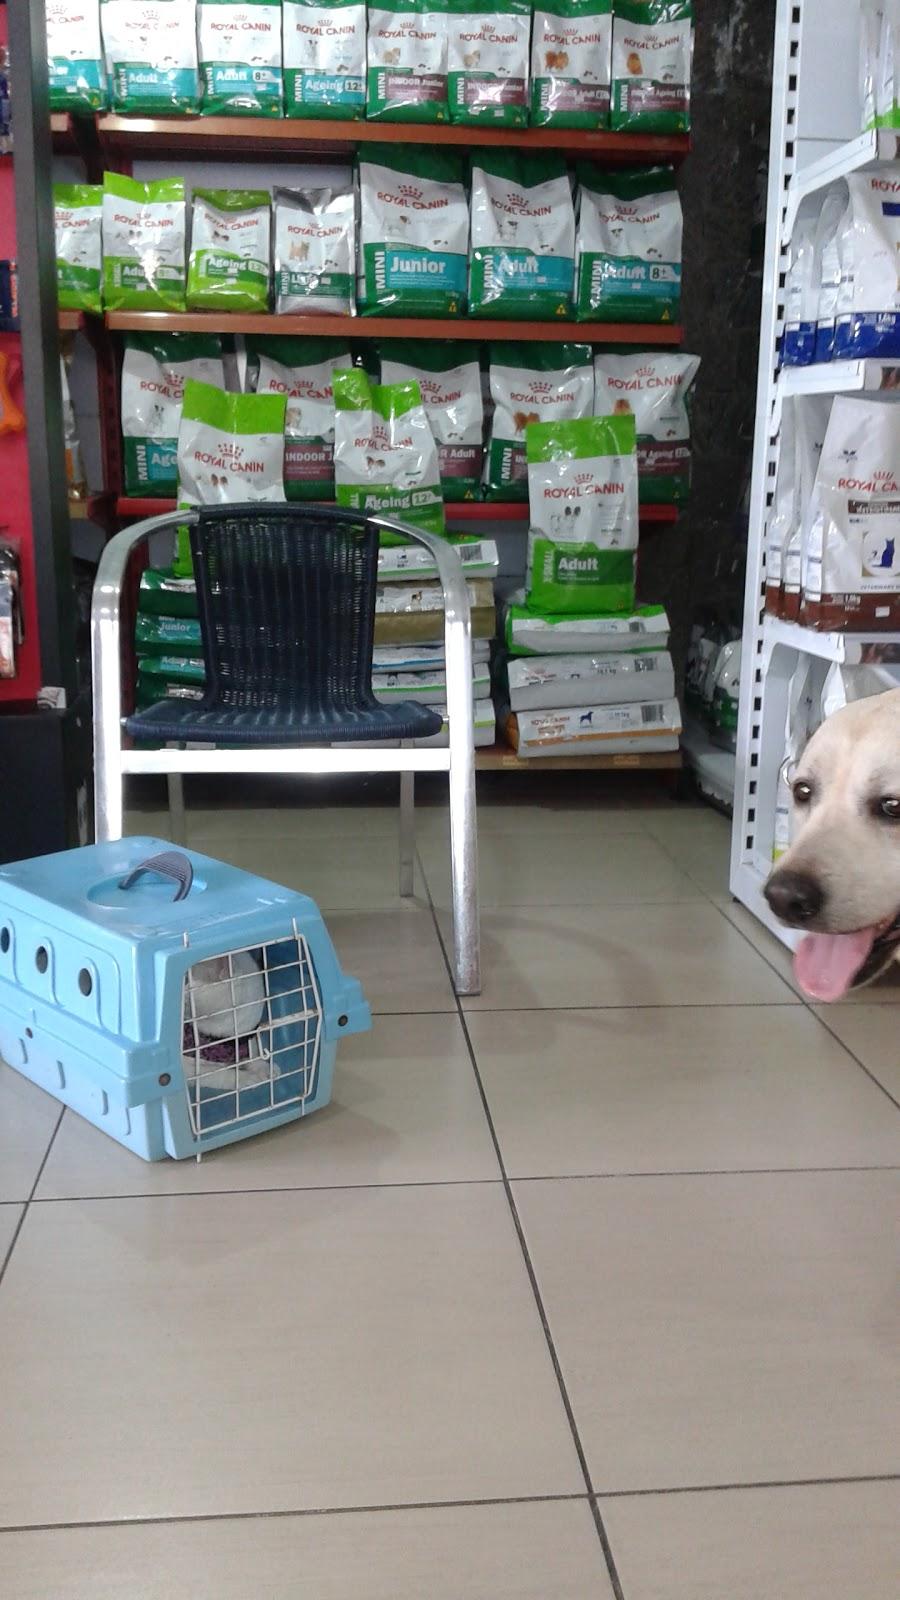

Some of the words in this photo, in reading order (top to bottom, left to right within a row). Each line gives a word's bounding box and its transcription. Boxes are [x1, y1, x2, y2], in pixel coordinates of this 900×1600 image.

[210, 22, 239, 31] ROYAL
[242, 23, 272, 32] CANIN
[296, 24, 323, 36] ROYAL
[326, 24, 355, 35] CANIN
[378, 29, 409, 39] ROYAL
[411, 31, 437, 41] CANIN
[459, 33, 486, 42] ROYAL
[488, 34, 518, 43] CANIN
[543, 34, 570, 46] ROYAL
[572, 33, 601, 45] CANIN
[623, 37, 650, 50] ROYAL
[652, 35, 680, 50] CANIN
[129, 72, 158, 84] Adult
[216, 70, 248, 81] Adult
[294, 74, 302, 102] MINI
[305, 79, 342, 92] Ageing
[378, 72, 386, 100] MINI
[457, 77, 465, 105] MINI
[620, 84, 629, 112] MINI
[871, 178, 900, 192] ROYA
[376, 191, 410, 208] ROYAL
[412, 198, 449, 210] CANIN
[490, 197, 517, 216] ROYAL
[519, 205, 553, 217] CANIN
[113, 214, 142, 227] ROYAL
[144, 218, 174, 228] CANIN
[204, 212, 229, 231] ROYAL
[231, 218, 259, 231] CANIN
[629, 212, 661, 224] CANIN
[287, 225, 315, 237] ROYAL
[316, 226, 343, 238] CANIN
[208, 257, 247, 271] Ageing
[374, 251, 386, 290] MINI
[390, 257, 447, 274] Junior
[483, 254, 494, 289] MINI
[501, 256, 540, 276] Adult
[280, 272, 290, 296] MINI
[140, 380, 171, 398] ROYAL
[270, 379, 306, 399] ROYAL
[307, 385, 334, 400] CAN
[608, 377, 642, 391] ROYAL
[645, 374, 684, 390] CANIN
[431, 390, 462, 404] CANIN
[510, 392, 540, 405] ROYAL
[541, 392, 575, 405] CANIN
[354, 437, 379, 450] ROYAL
[286, 452, 325, 462] INDOOR
[450, 448, 475, 459] Adult
[136, 444, 148, 481] MINI
[194, 450, 227, 470] ROYAL
[229, 463, 265, 473] CANIN
[501, 447, 512, 480] MINI
[544, 486, 583, 498] ROYAL
[586, 483, 625, 496] CANIN
[838, 477, 877, 492] ROYAL
[365, 494, 410, 511] Ageing
[558, 556, 599, 571] Adult
[160, 622, 191, 632] Junior
